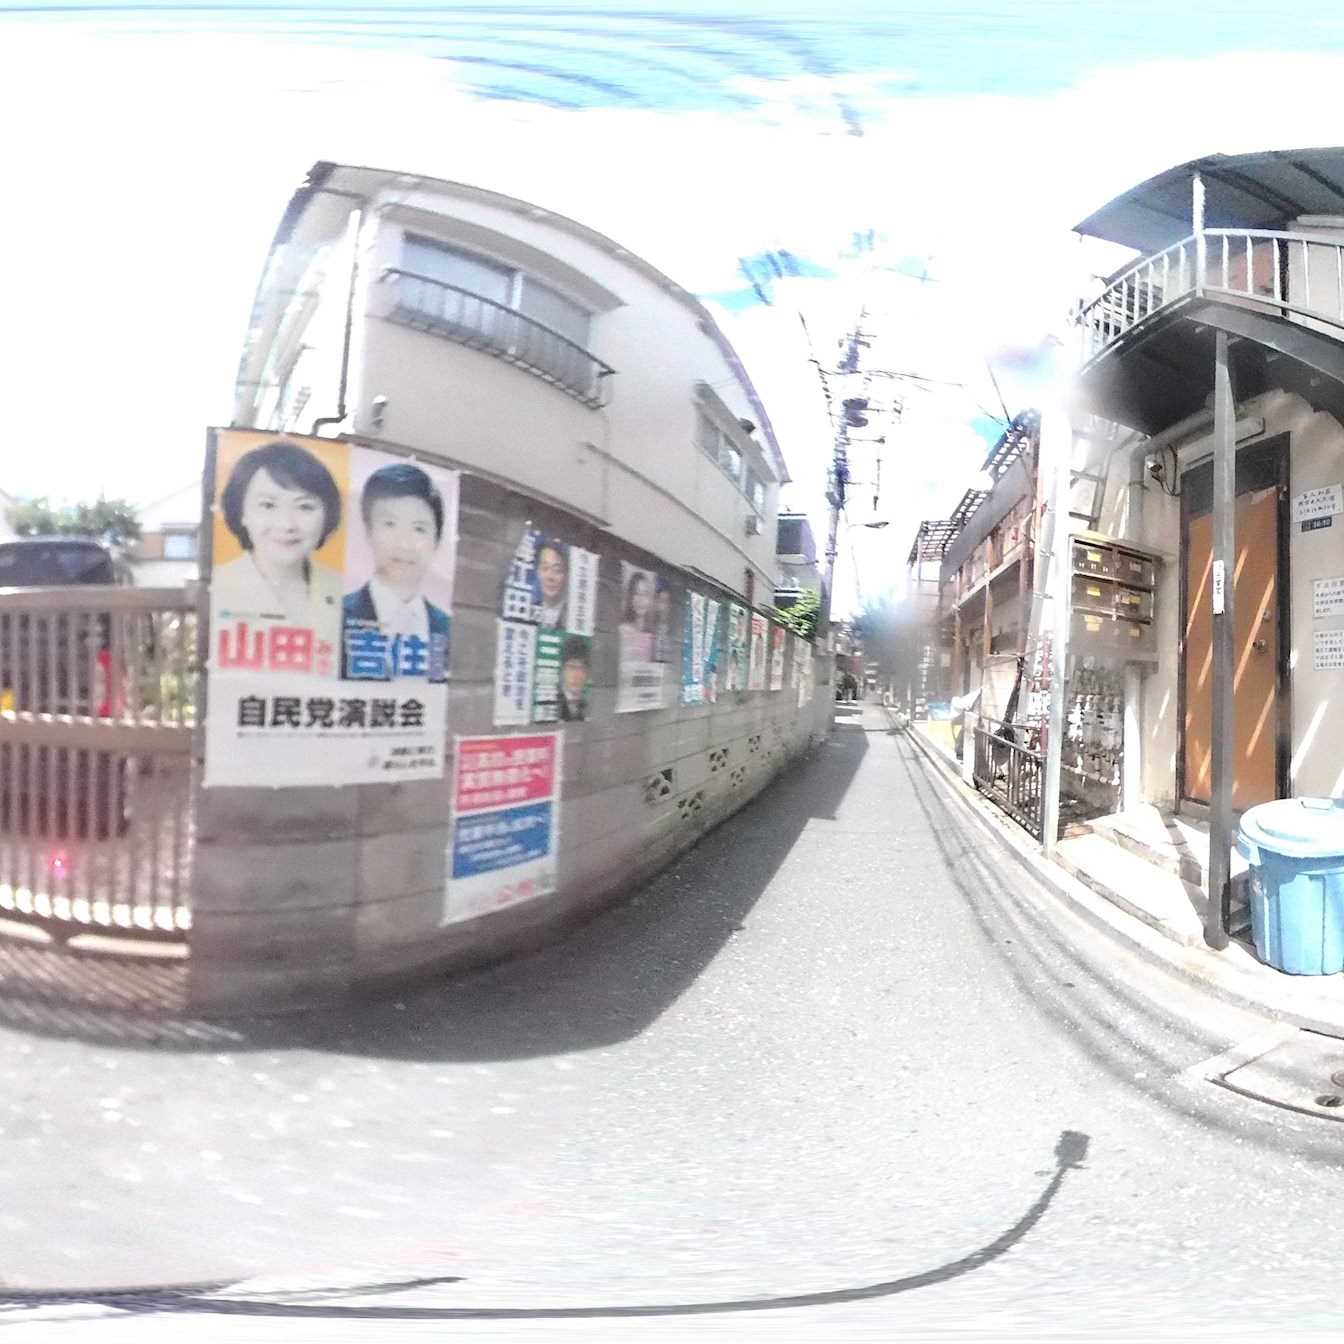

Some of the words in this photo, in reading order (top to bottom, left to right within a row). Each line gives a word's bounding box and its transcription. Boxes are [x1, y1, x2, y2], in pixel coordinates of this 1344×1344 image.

[218, 622, 314, 672] 山田
[350, 631, 427, 676] 吉住
[237, 695, 425, 727] 自民党演説会
